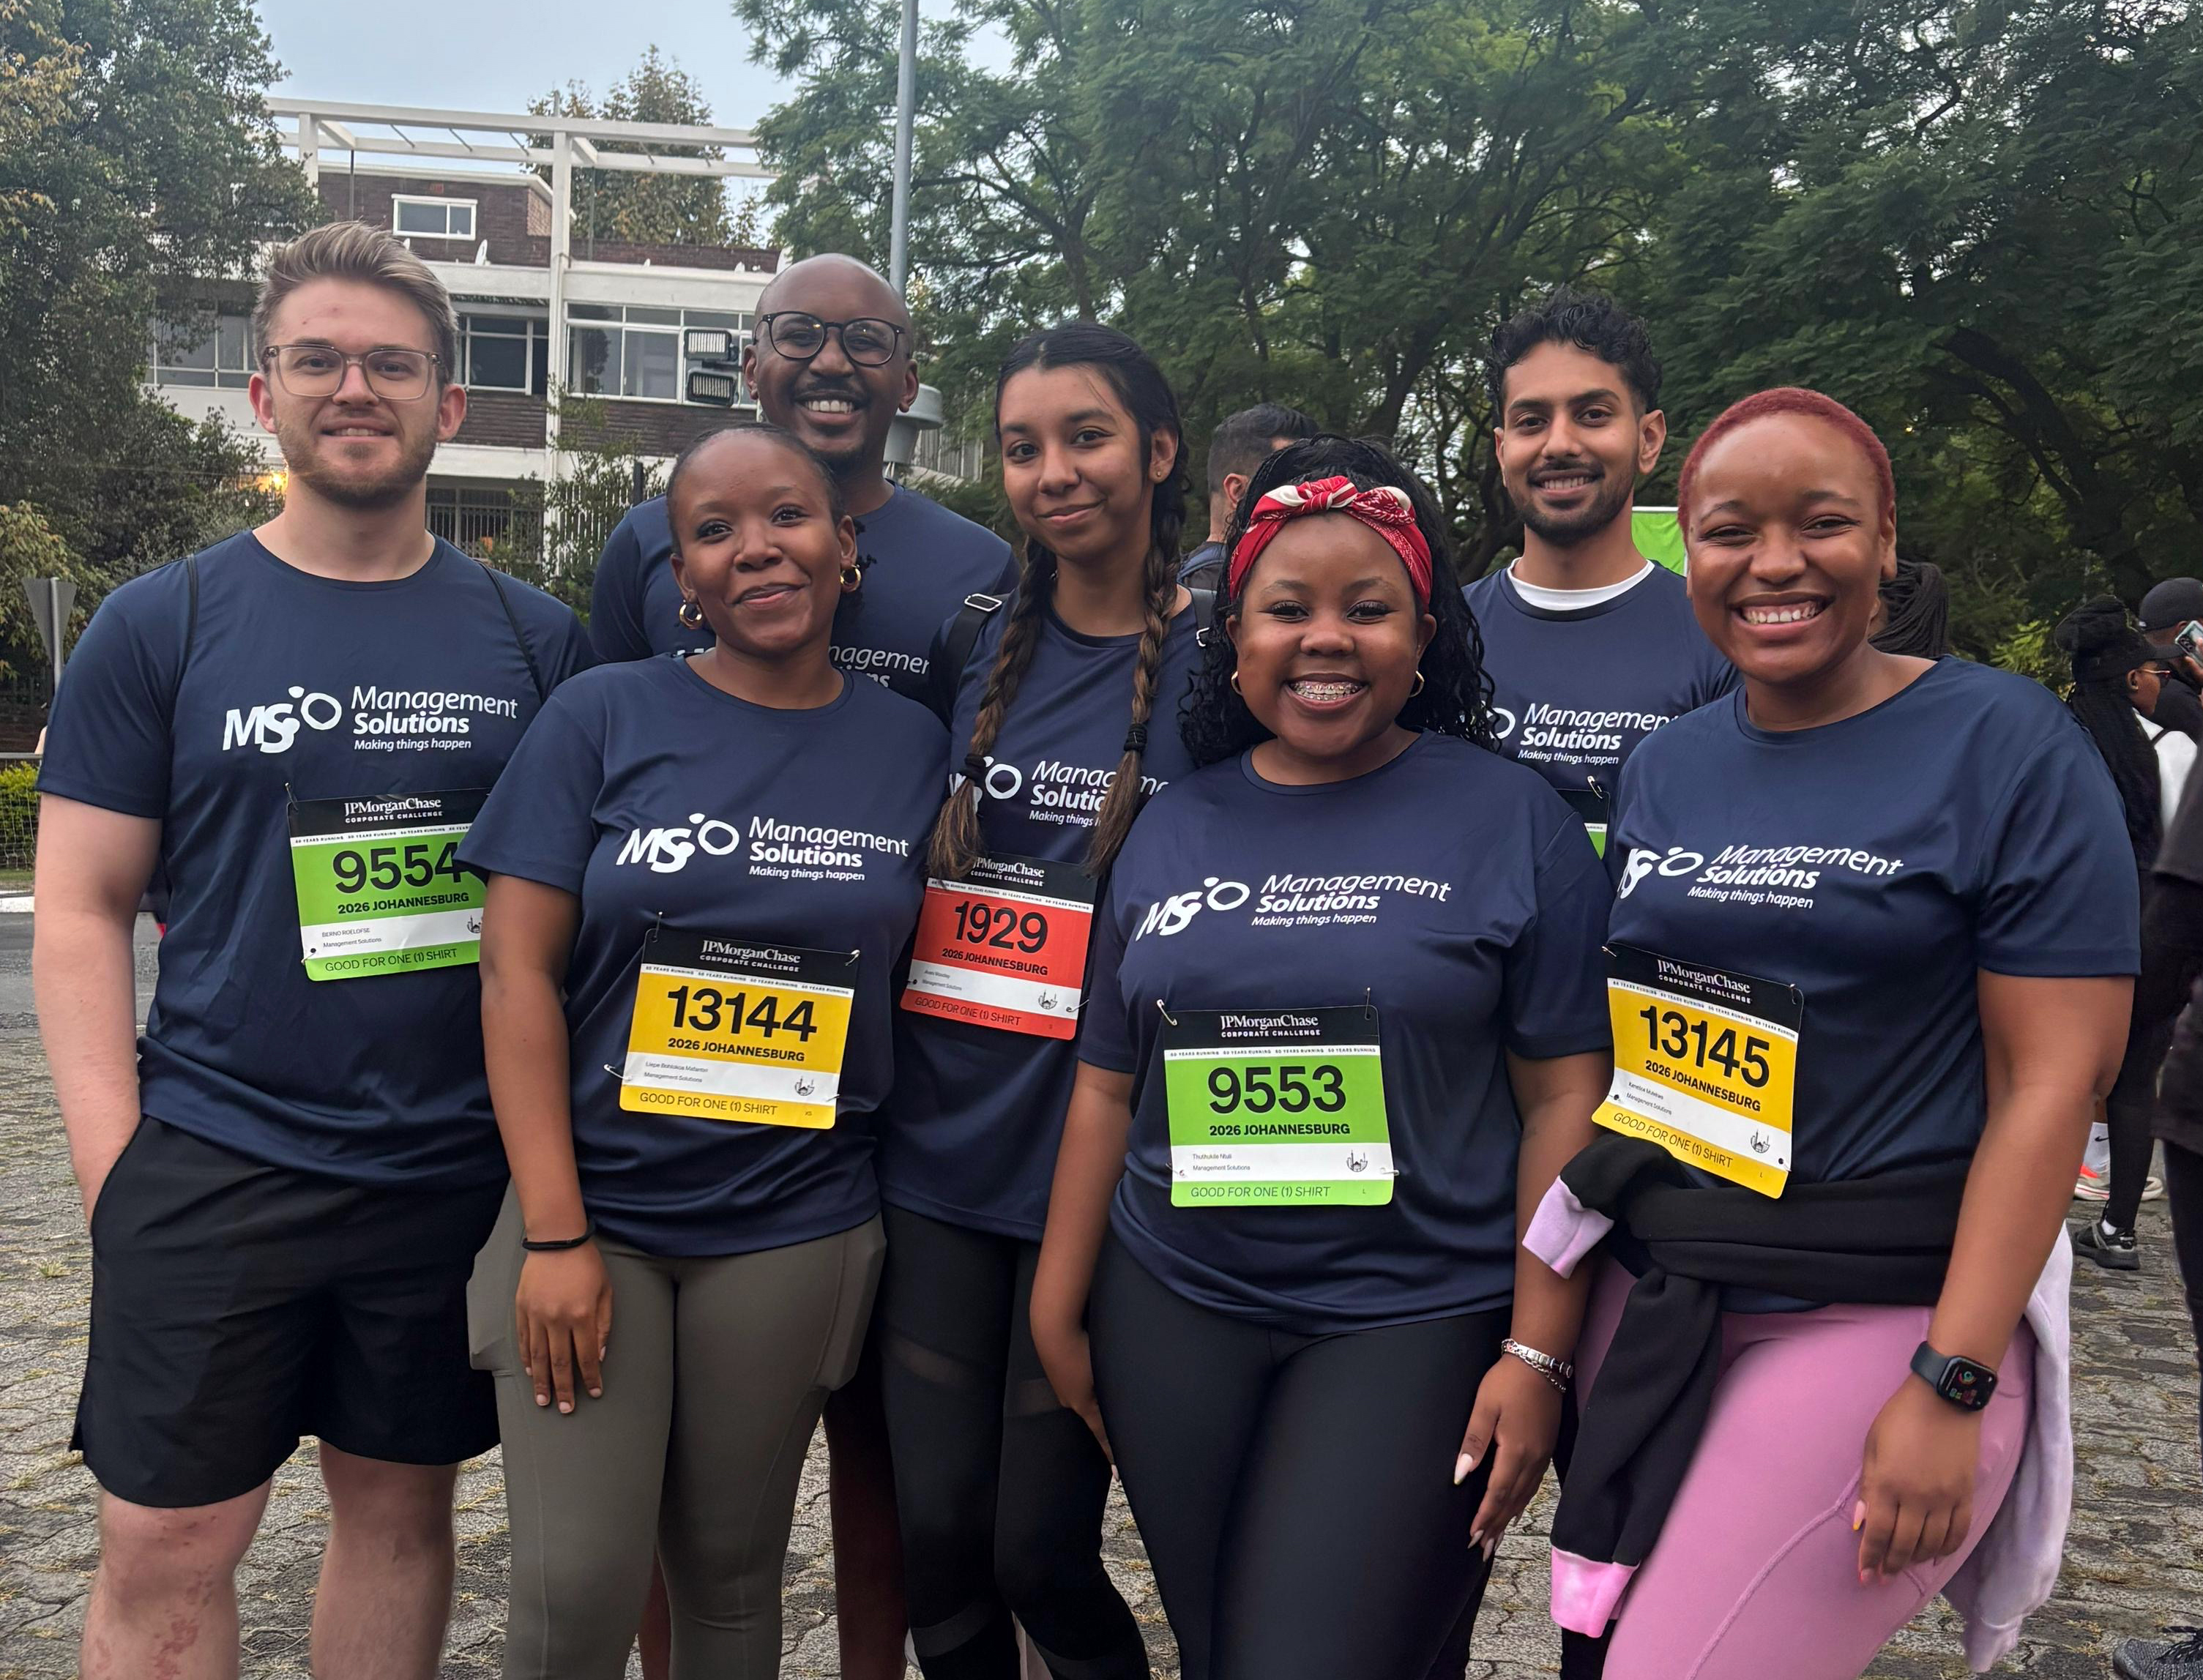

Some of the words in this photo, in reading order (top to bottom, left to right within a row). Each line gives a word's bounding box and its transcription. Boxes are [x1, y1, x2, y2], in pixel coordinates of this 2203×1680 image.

[351, 686, 518, 719] Management
[352, 712, 469, 735] Solutions
[355, 739, 394, 752] Making
[397, 739, 428, 751] things
[431, 739, 471, 750] happen
[1521, 727, 1622, 750] Solutions
[1518, 750, 1552, 762] Making
[1553, 752, 1582, 765] things
[1584, 754, 1619, 765] happen
[343, 796, 442, 817] JPMorganChase
[345, 814, 394, 823] CORPORATE
[397, 810, 442, 819] CHALLENGE
[1029, 810, 1065, 824] Making
[1066, 813, 1094, 827] things
[749, 816, 909, 856] Management
[750, 842, 862, 867] Solutions
[1711, 845, 1904, 876] Management
[331, 841, 469, 895] 9554
[749, 865, 789, 879] Making
[791, 868, 824, 879] things
[826, 869, 865, 881] happen
[970, 870, 1002, 880] CORPORATE
[1004, 875, 1043, 886] CHALLENGE
[972, 856, 1045, 880] JPMorganChase
[1696, 865, 1820, 889] Solutions
[1260, 874, 1451, 902] Management
[1687, 886, 1729, 902] Making
[1730, 889, 1764, 903] things
[1767, 891, 1814, 908] happen
[337, 902, 370, 914] 2026
[371, 892, 469, 911] JOHANNESBURG
[1256, 893, 1380, 913] Solutions
[950, 899, 1050, 955] 1929
[1251, 916, 1293, 927] Making
[1296, 915, 1330, 927] things
[1332, 913, 1376, 925] happen
[323, 939, 357, 948] Management
[701, 940, 801, 966] JPMorganChase
[324, 959, 360, 971] GOOD
[362, 956, 386, 968] FOR
[387, 954, 411, 965] ONE
[413, 952, 425, 963] (1)
[426, 949, 458, 960] SHIRT
[699, 955, 748, 966] CORPORATE
[751, 961, 799, 972] CHALLENGE
[942, 948, 963, 960] 2026
[963, 952, 1048, 976] JOHANNESBURG
[1657, 958, 1751, 998] JPMorganChase
[1658, 973, 1702, 991] CORPORATE
[1706, 986, 1751, 1005] CHALLENGE
[663, 983, 821, 1043] 13144
[914, 996, 941, 1009] GOOD
[942, 1002, 960, 1014] FOR
[960, 1006, 978, 1018] ONE
[979, 1009, 989, 1020] (1)
[990, 1012, 1021, 1026] SHIRT
[1220, 1013, 1318, 1030] JPMorganChase
[667, 1037, 700, 1050] 2026
[701, 1041, 805, 1061] JOHANNESBURG
[1639, 1001, 1771, 1091] 13145
[1207, 1064, 1347, 1114] 9553
[1645, 1059, 1670, 1078] 2026
[1671, 1069, 1760, 1113] JOHANNESBURG
[639, 1092, 675, 1105] GOOD
[676, 1096, 701, 1107] FOR
[702, 1099, 728, 1110] ONE
[729, 1101, 742, 1113] (1)
[742, 1102, 778, 1115] SHIRT
[1209, 1125, 1240, 1135] 2026
[1243, 1123, 1350, 1135] JOHANNESBURG
[1614, 1110, 1645, 1132] GOOD
[1647, 1124, 1668, 1143] FOR
[1669, 1133, 1690, 1151] ONE
[1691, 1141, 1701, 1157] (1)
[1703, 1147, 1733, 1170] SHIRT
[1190, 1187, 1225, 1197] GOOD
[1227, 1187, 1251, 1197] FOR
[1253, 1187, 1278, 1196] ONE
[1281, 1187, 1293, 1198] (1)
[1294, 1187, 1330, 1196] SHIRT
